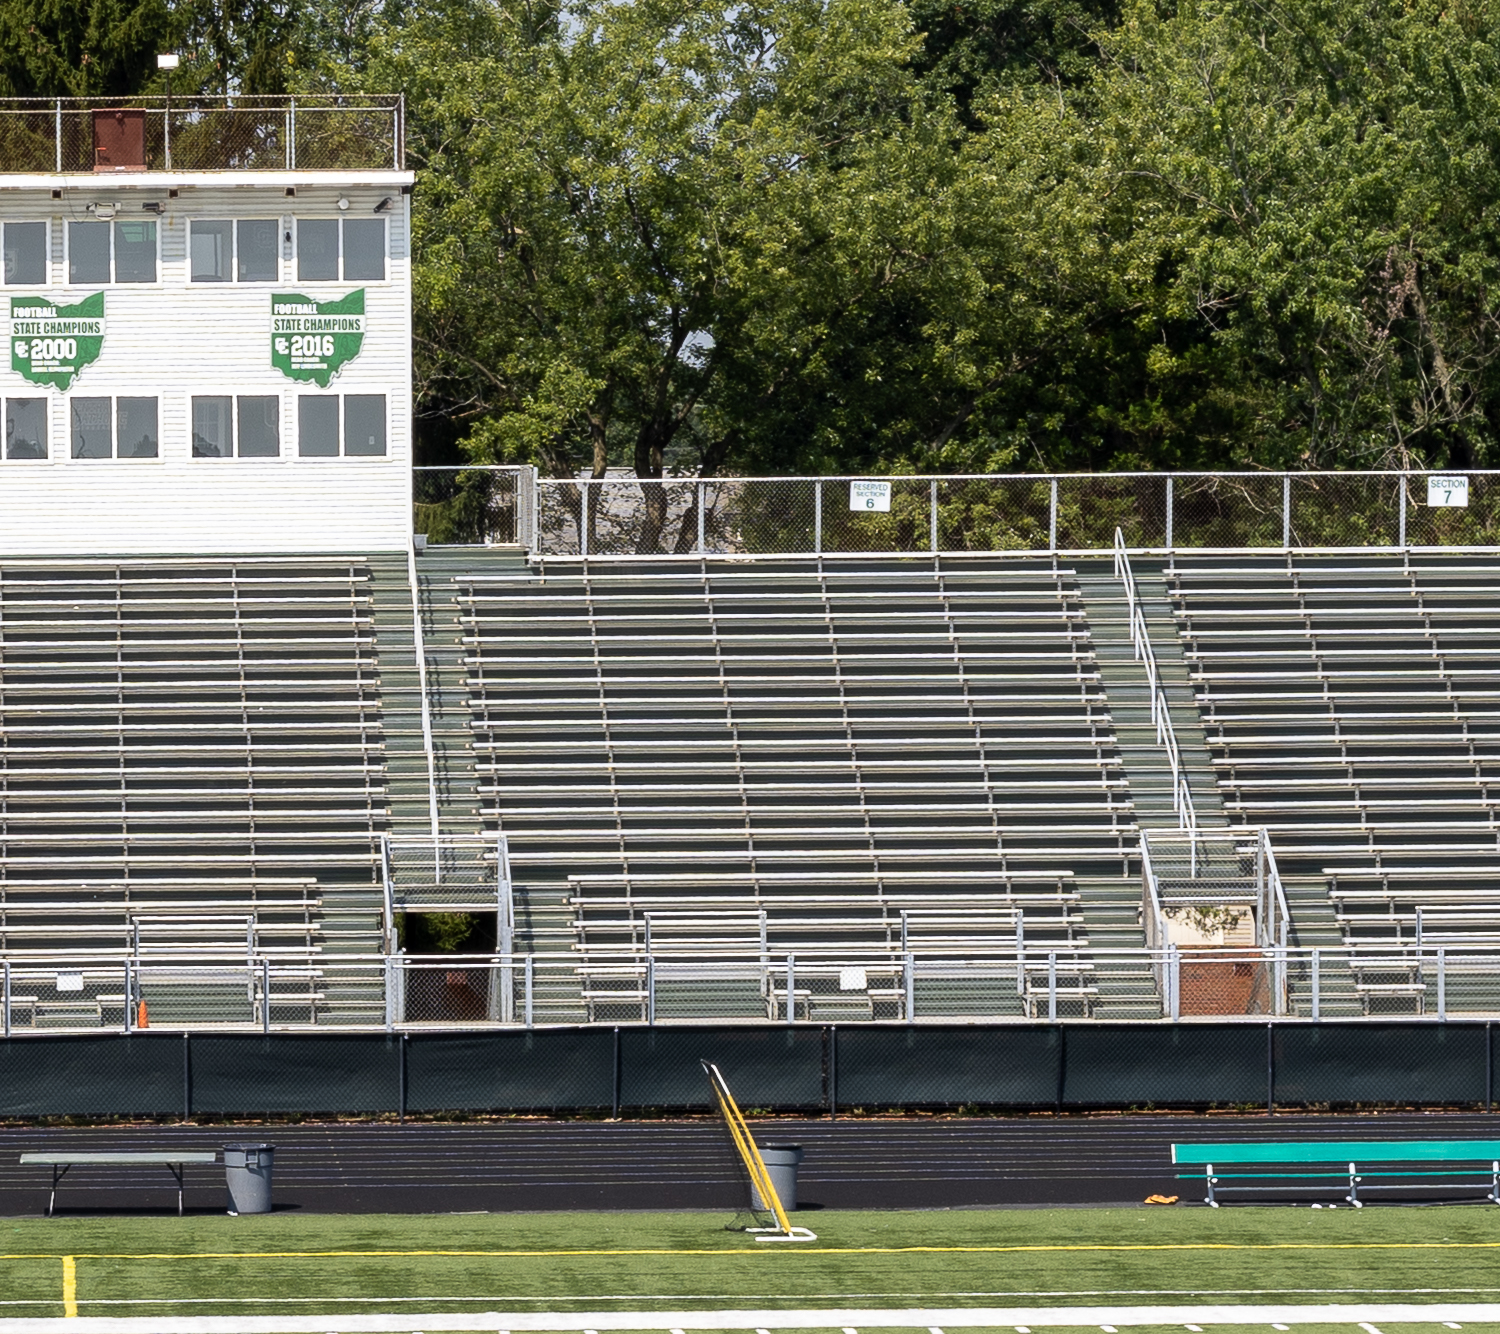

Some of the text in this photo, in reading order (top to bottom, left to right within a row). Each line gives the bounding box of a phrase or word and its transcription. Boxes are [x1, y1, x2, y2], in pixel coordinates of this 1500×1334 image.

[13, 307, 57, 318] FOOTBALL
[274, 303, 318, 314] FOOTBALL
[13, 322, 100, 334] STATE CHAMPIONS
[274, 318, 361, 331] STATE CHAMPIONS
[30, 338, 77, 359] 2000
[291, 335, 334, 356] 2016
[853, 483, 888, 491] RESERVED
[1430, 479, 1466, 488] SECTION
[1444, 490, 1452, 504] 7
[866, 498, 875, 509] 6
